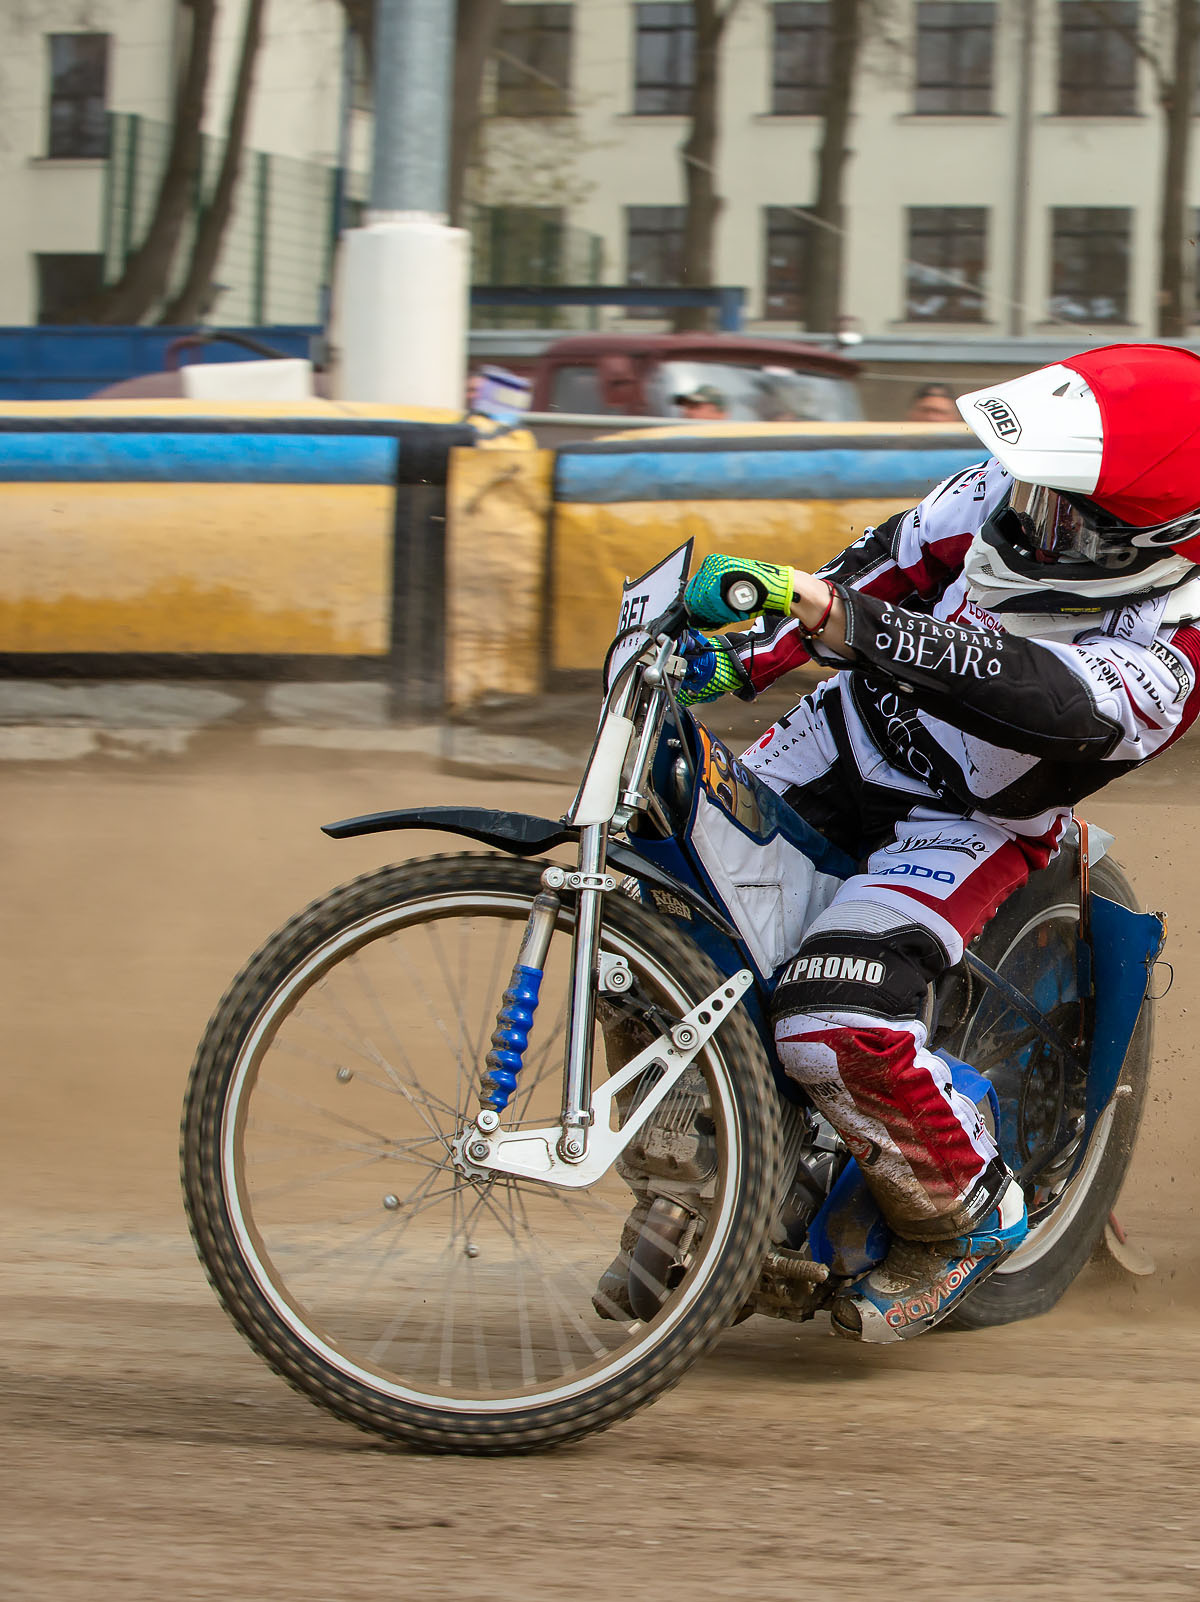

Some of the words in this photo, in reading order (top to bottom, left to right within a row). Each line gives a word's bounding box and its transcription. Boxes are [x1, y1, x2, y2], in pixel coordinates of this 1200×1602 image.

[978, 399, 1018, 437] SHOEI
[881, 613, 1004, 651] GASTROBARS
[892, 630, 987, 679] BEAR
[885, 1255, 985, 1328] dayton
